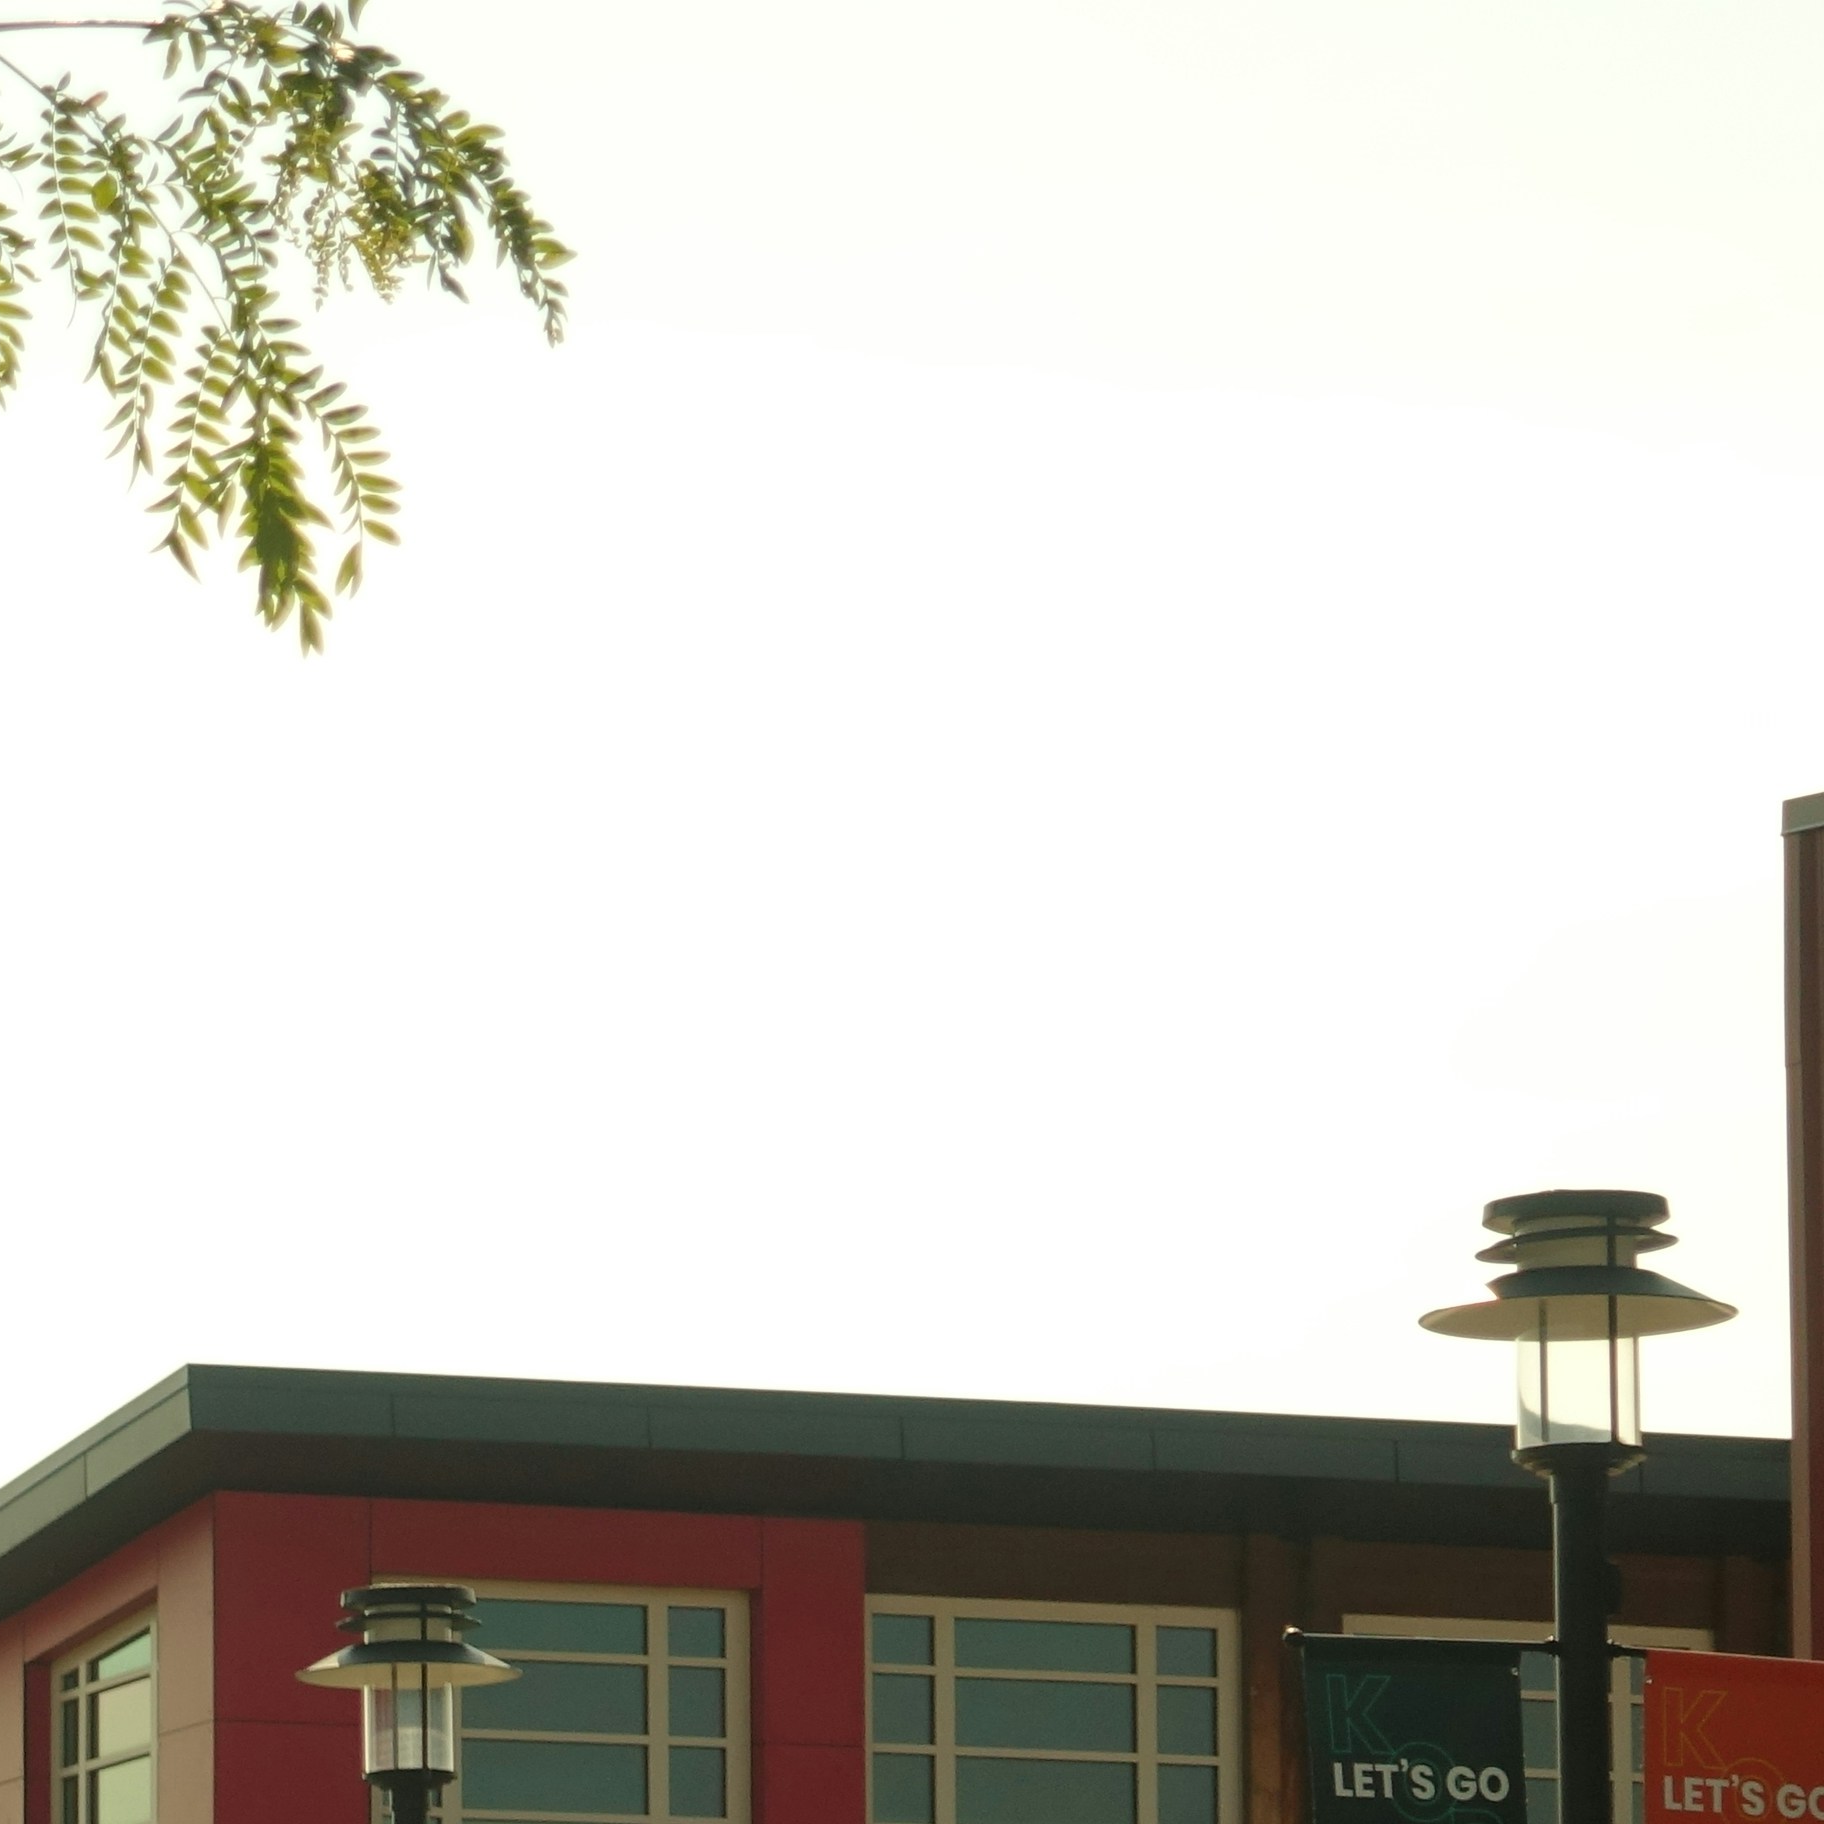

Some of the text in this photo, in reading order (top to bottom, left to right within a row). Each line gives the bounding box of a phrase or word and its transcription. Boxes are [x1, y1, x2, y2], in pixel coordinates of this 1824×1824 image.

[1333, 1758, 1510, 1801] LET'S GO
[1664, 1774, 1765, 1817] LET'S
